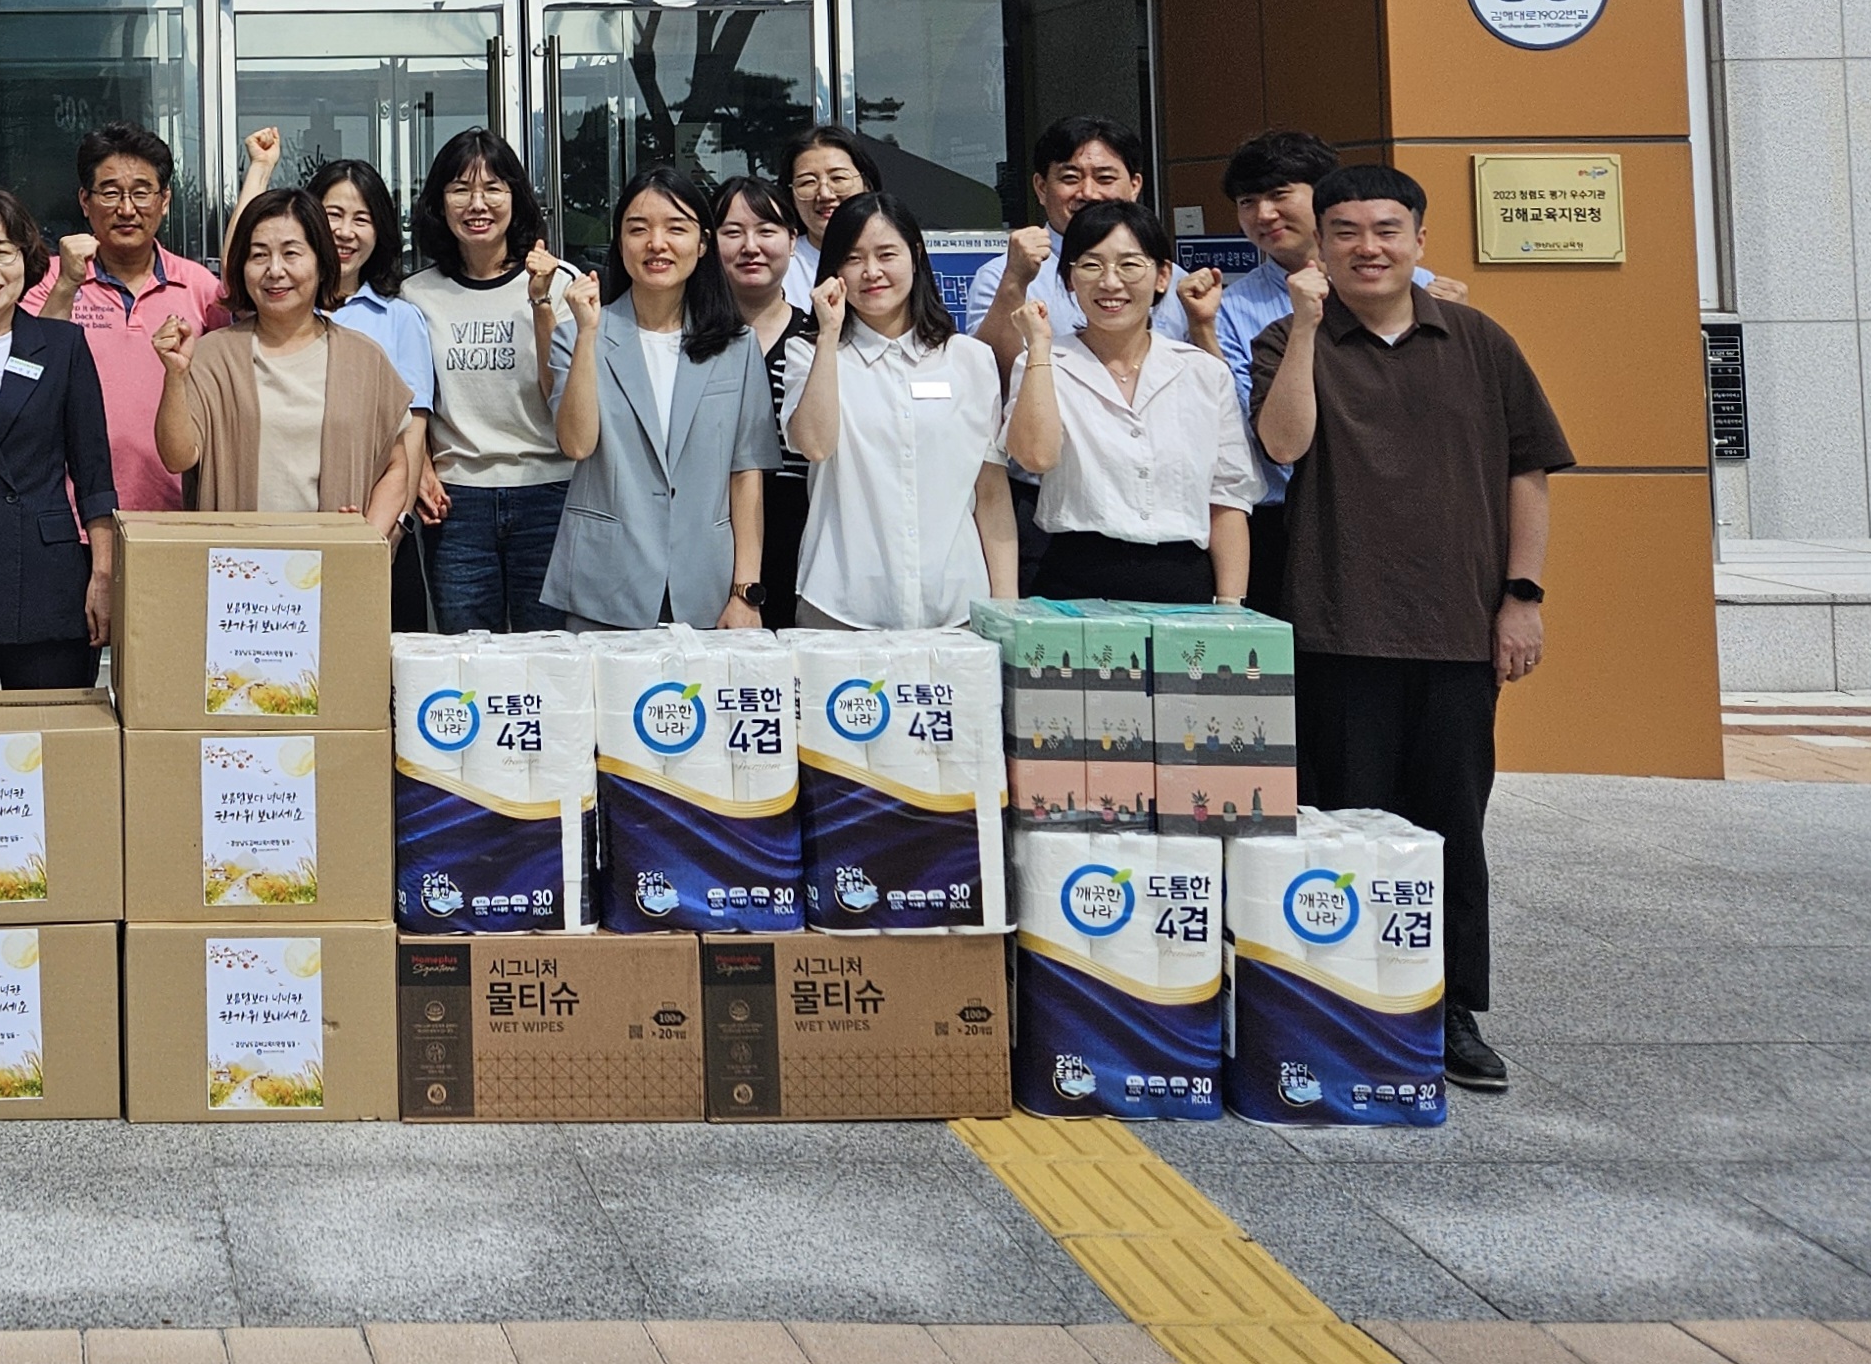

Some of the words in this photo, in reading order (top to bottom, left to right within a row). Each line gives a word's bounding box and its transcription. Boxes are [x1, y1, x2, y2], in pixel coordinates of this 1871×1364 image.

[1490, 9, 1589, 22] 김해대로1902번길
[1493, 190, 1517, 200] 2023
[1519, 190, 1546, 200] 청렴도
[1500, 207, 1602, 223] 김해교육지원청
[450, 321, 514, 344] VIEN
[446, 347, 515, 371] NOIS
[226, 602, 268, 616] 보름달보다
[218, 619, 257, 634] 한가위
[261, 619, 309, 634] 보내세요
[715, 687, 782, 713] 도톰한
[896, 683, 954, 707] 도톰한
[485, 694, 543, 716] 도톰한
[647, 703, 693, 720] 깨끗한
[838, 698, 878, 713] 깨끗한
[430, 707, 468, 723] 깨끗한
[846, 713, 871, 726] 나라
[436, 723, 462, 736] 나라
[655, 721, 685, 737] 나라
[908, 710, 954, 743] 4겹
[496, 720, 542, 752] 4겹
[728, 718, 782, 754] 4겹
[221, 792, 263, 806] 보름달보다
[214, 808, 254, 824] 한가위
[257, 808, 305, 823] 보내세요
[773, 887, 794, 904] 30
[949, 883, 970, 900] 30
[1075, 886, 1121, 903] 깨끗한
[1145, 876, 1211, 901] 도톰한
[1370, 880, 1435, 906] 도톰한
[532, 889, 553, 906] 30
[949, 900, 970, 910] ROLL
[1298, 893, 1345, 910] 깨끗한
[532, 906, 553, 916] ROLL
[773, 904, 794, 914] ROLL
[1082, 904, 1113, 919] 나라
[1155, 906, 1208, 942] 4겹
[1306, 910, 1337, 926] 나라
[1381, 911, 1432, 948] 4겹
[489, 958, 557, 978] 시그니처
[792, 957, 862, 977] 시그니처
[226, 992, 269, 1005] 보름달보다
[485, 982, 580, 1016] 물티슈
[789, 980, 885, 1014] 물티슈
[218, 1009, 258, 1025] 한가위
[262, 1009, 311, 1024] 보내세요
[489, 1022, 520, 1033] WET
[523, 1021, 564, 1033] WIPES
[794, 1020, 825, 1032] WET
[828, 1020, 870, 1032] WIPES
[1190, 1077, 1212, 1094] 30
[1418, 1083, 1436, 1100] 30
[1191, 1094, 1212, 1105] ROLL
[1419, 1100, 1436, 1111] ROLL
